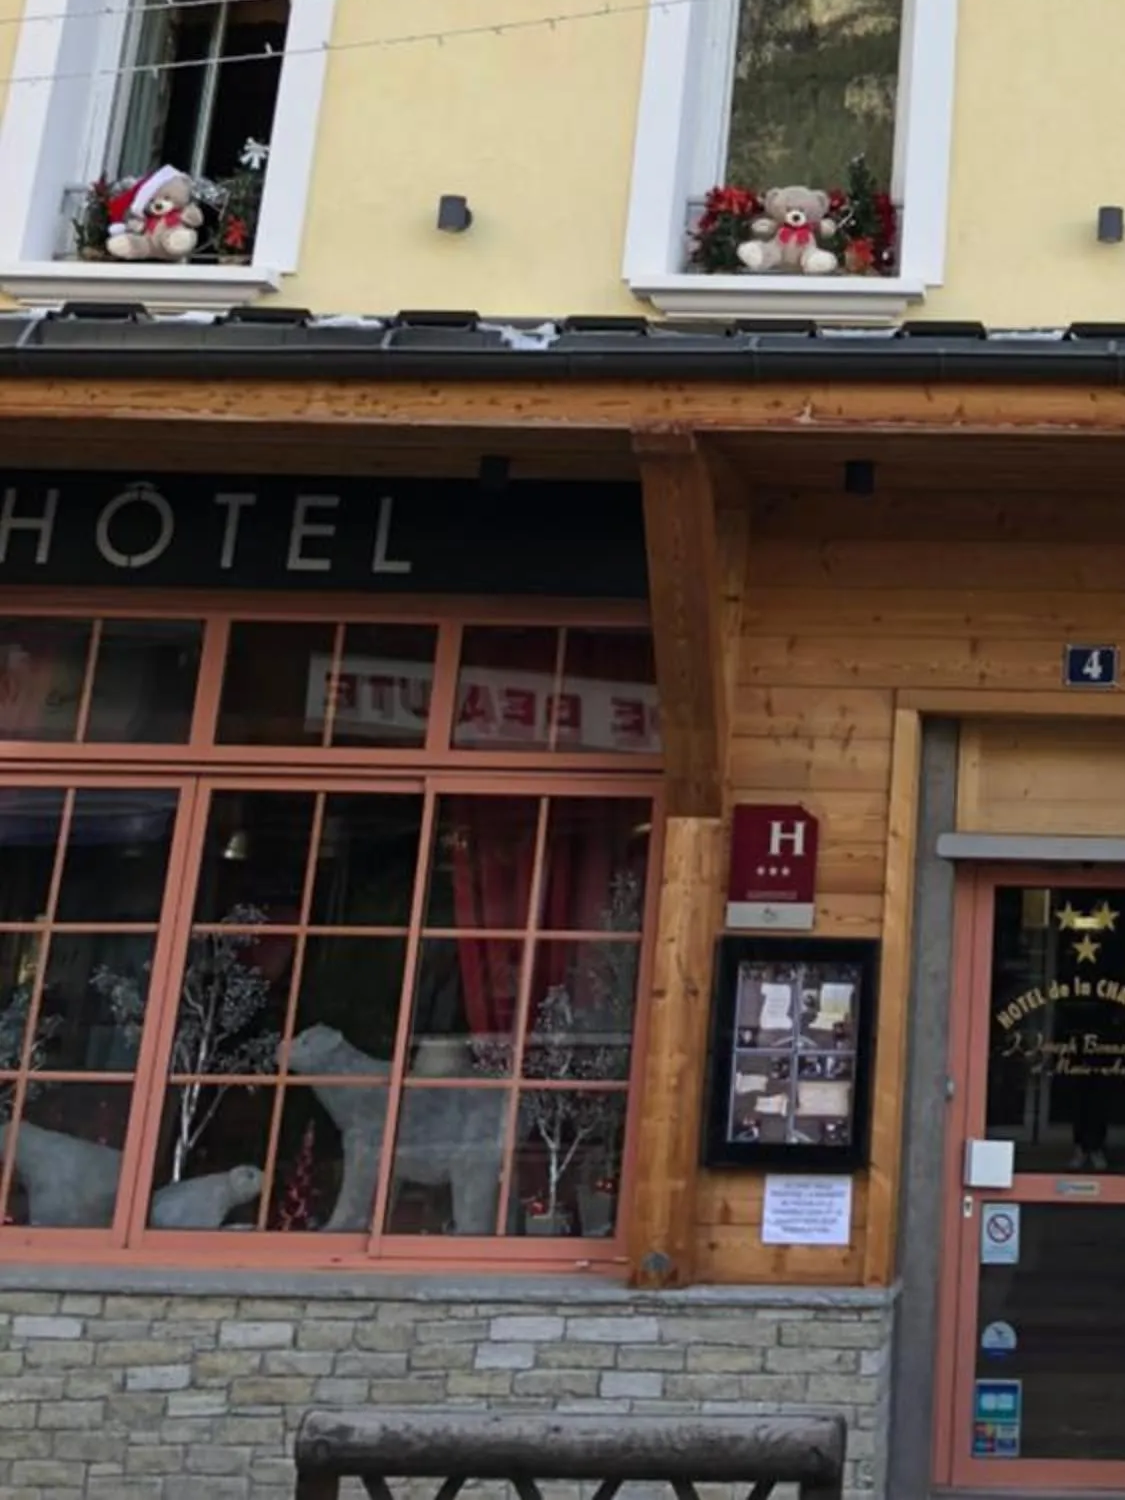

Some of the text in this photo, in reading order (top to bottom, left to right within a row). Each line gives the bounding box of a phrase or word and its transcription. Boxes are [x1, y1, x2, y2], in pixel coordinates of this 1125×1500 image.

[0, 481, 412, 574] HÔTEL
[1082, 650, 1103, 679] 4
[767, 820, 806, 856] H
[997, 987, 1047, 1030] HOTEL
[1049, 979, 1070, 999] de
[1073, 976, 1091, 997] la
